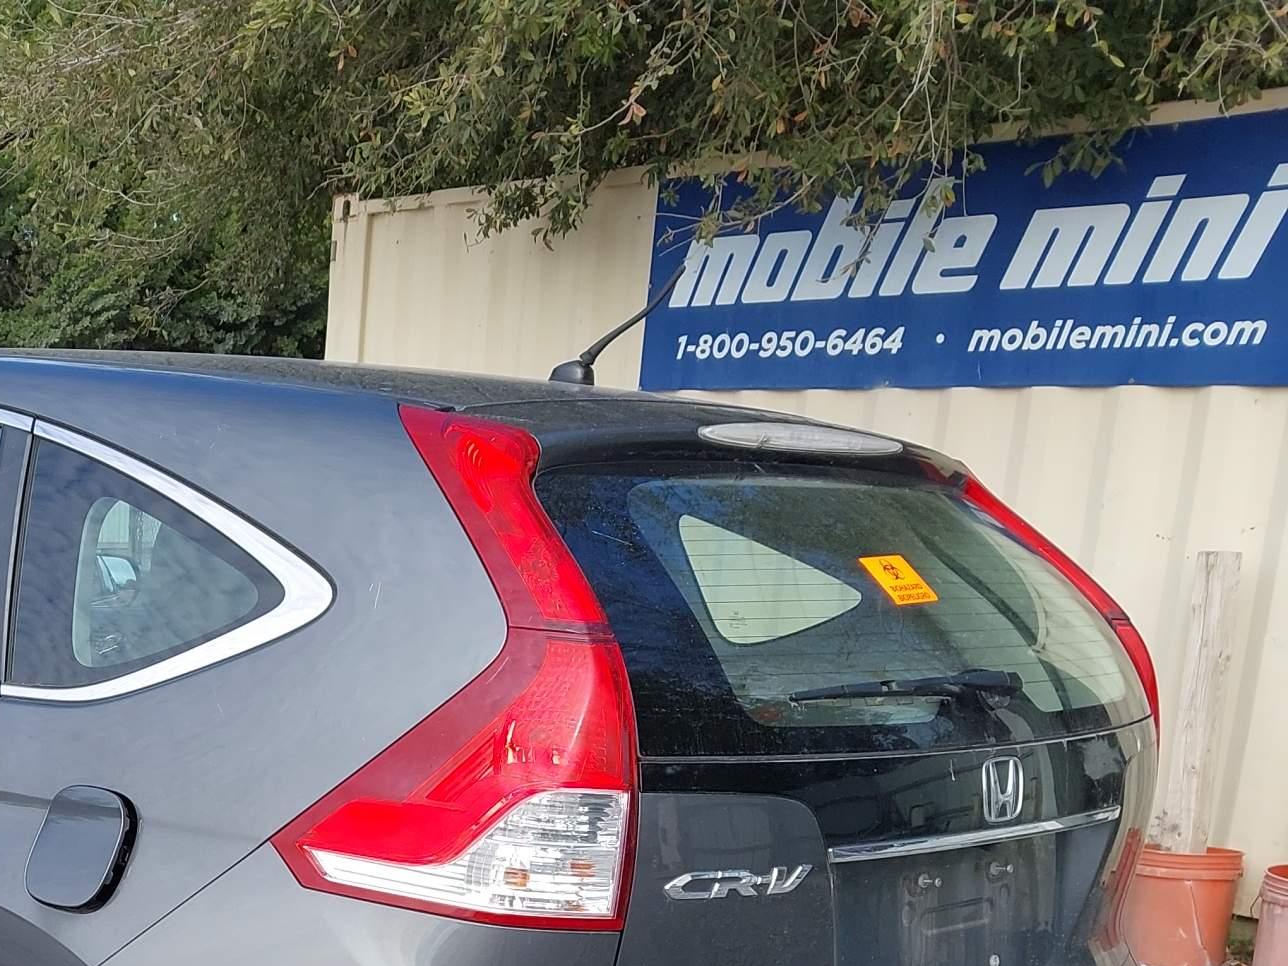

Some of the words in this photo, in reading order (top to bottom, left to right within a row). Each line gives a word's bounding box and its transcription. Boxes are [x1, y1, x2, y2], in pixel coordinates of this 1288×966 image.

[668, 178, 998, 308] mobile
[999, 163, 1288, 290] mini
[676, 326, 905, 360] 1-800-950-6464
[967, 316, 1268, 353] mobilemini.com
[664, 863, 813, 900] CR-V
